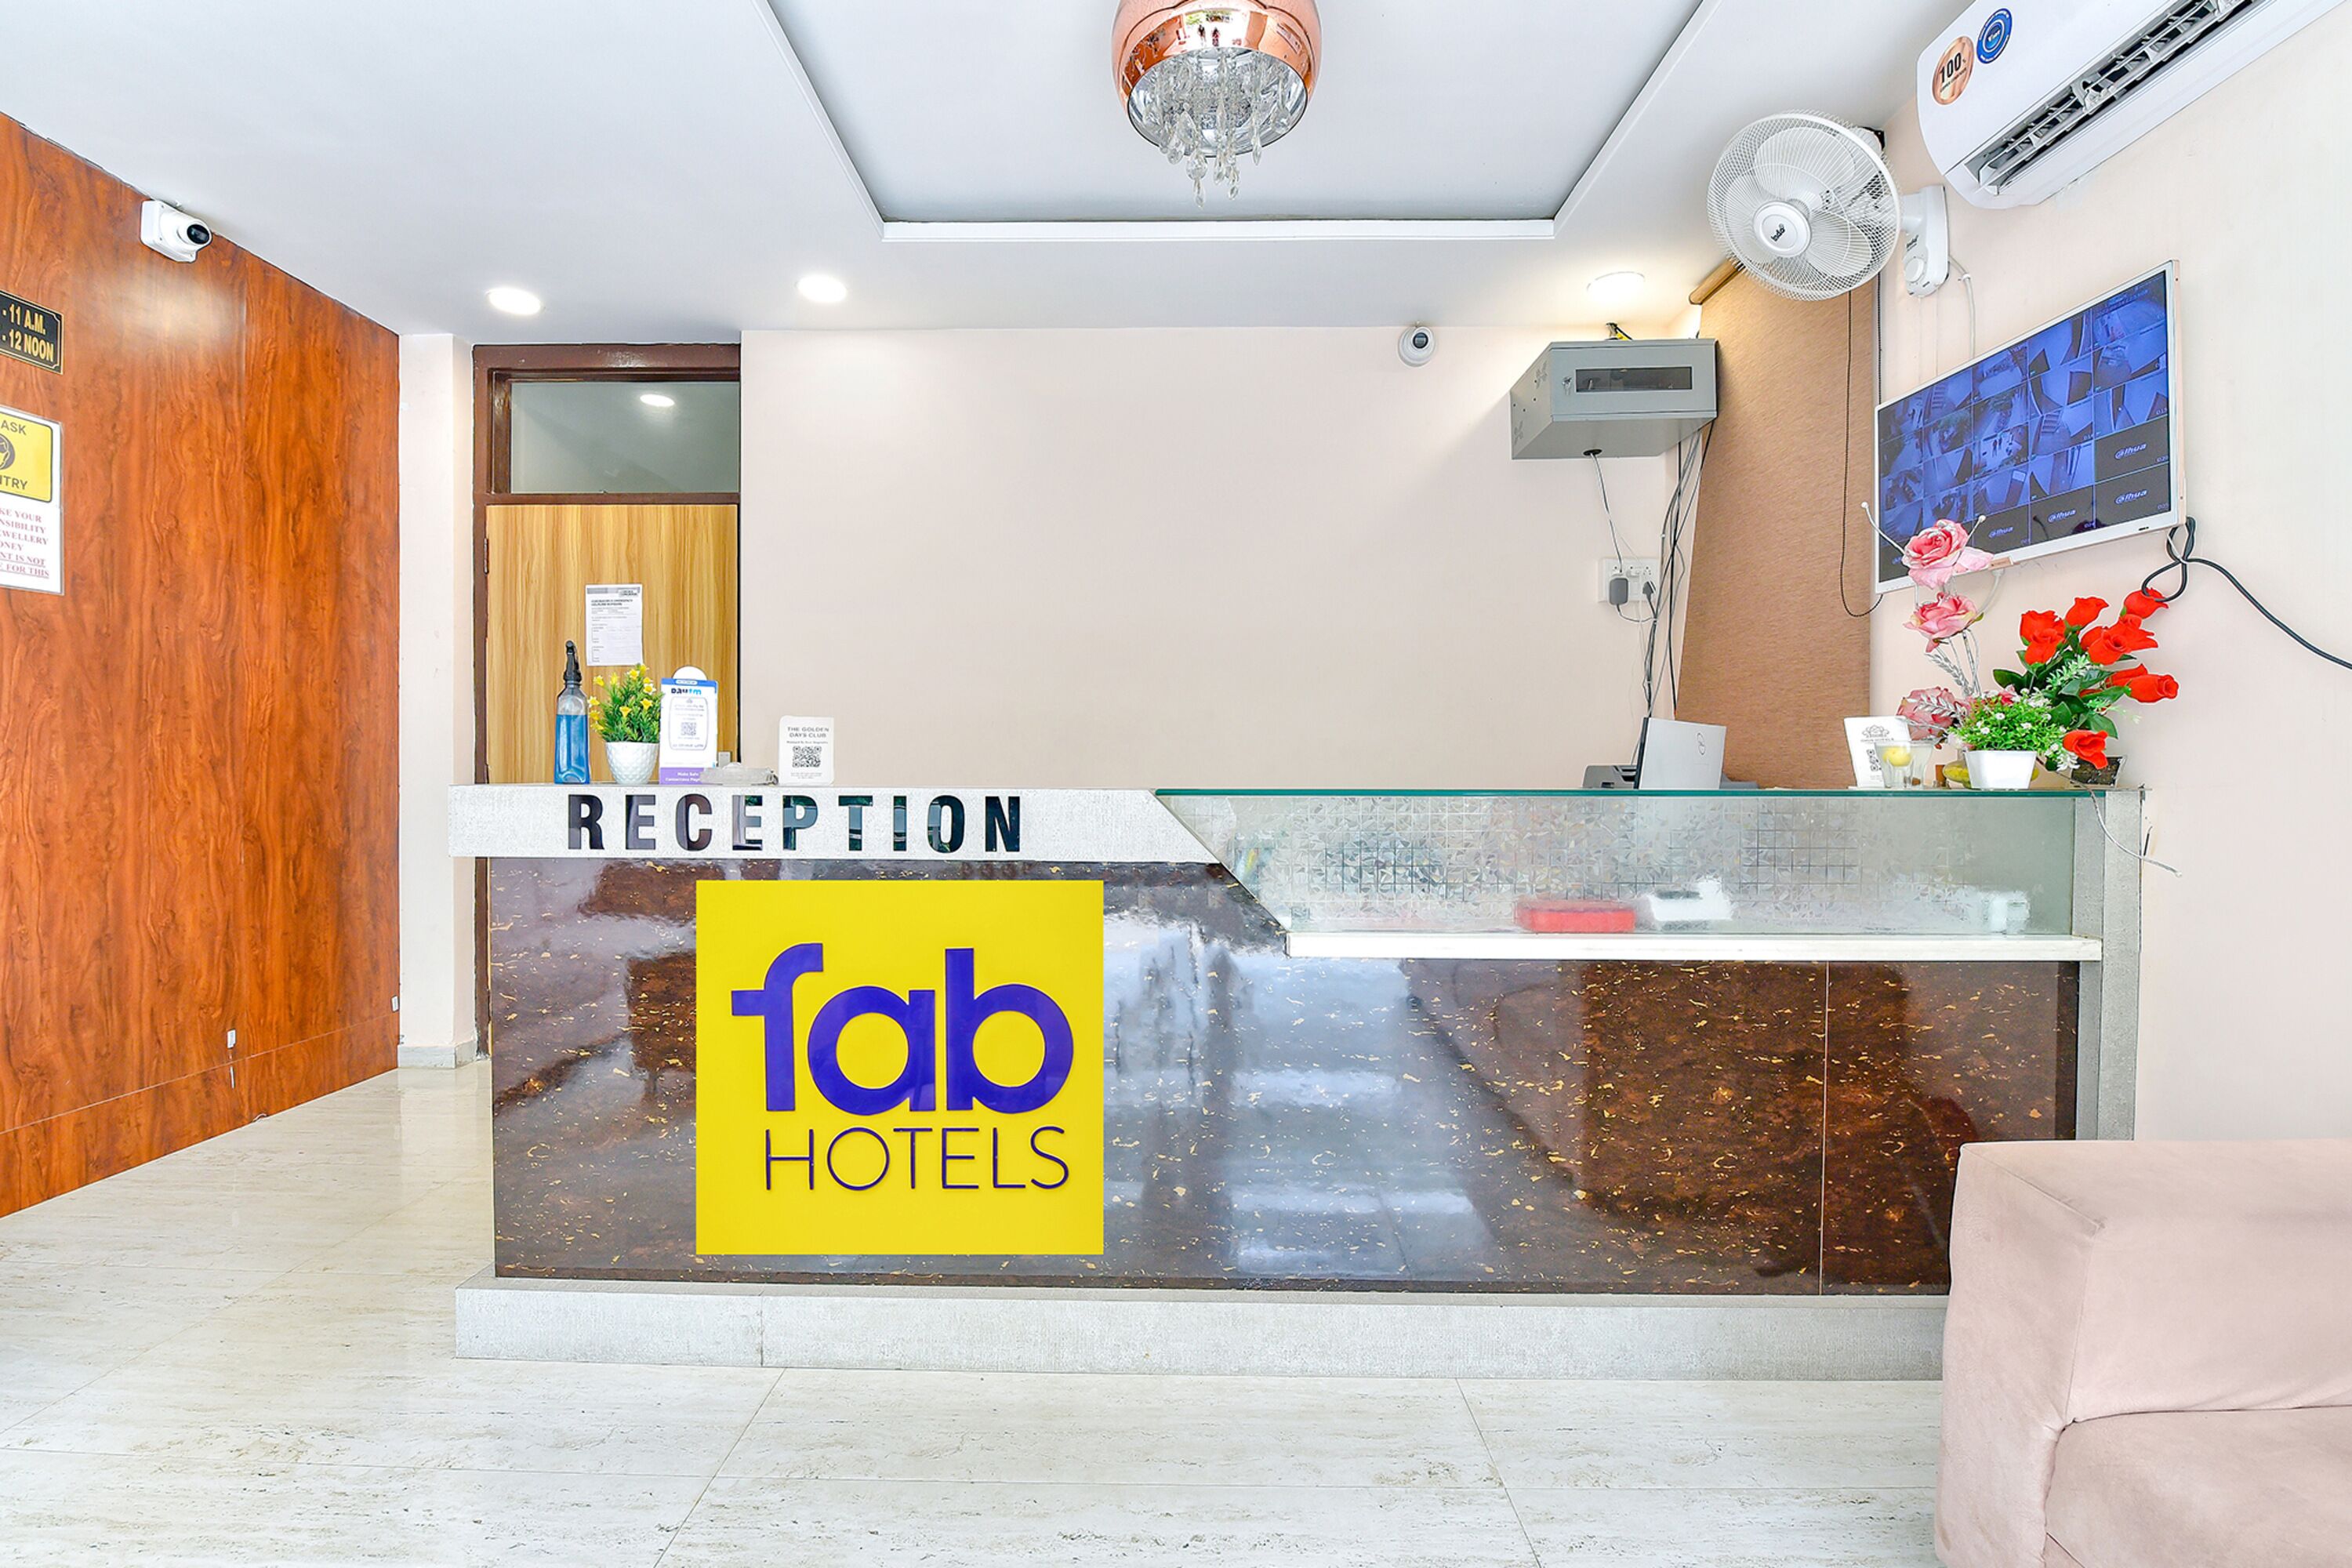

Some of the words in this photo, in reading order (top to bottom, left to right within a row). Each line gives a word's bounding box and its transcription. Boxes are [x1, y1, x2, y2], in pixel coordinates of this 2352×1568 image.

[9, 303, 21, 325] 11
[24, 309, 46, 336] A.M.
[9, 328, 22, 351] 12
[24, 333, 54, 362] NOON
[15, 510, 42, 524] YOUR
[0, 530, 49, 545] WELLERY
[6, 564, 26, 573] FOR
[28, 567, 49, 577] THIS
[27, 556, 45, 565] NOT
[568, 793, 1021, 853] RECEPTION
[731, 942, 1074, 1116] fab
[765, 1126, 1069, 1191] HOTELS
